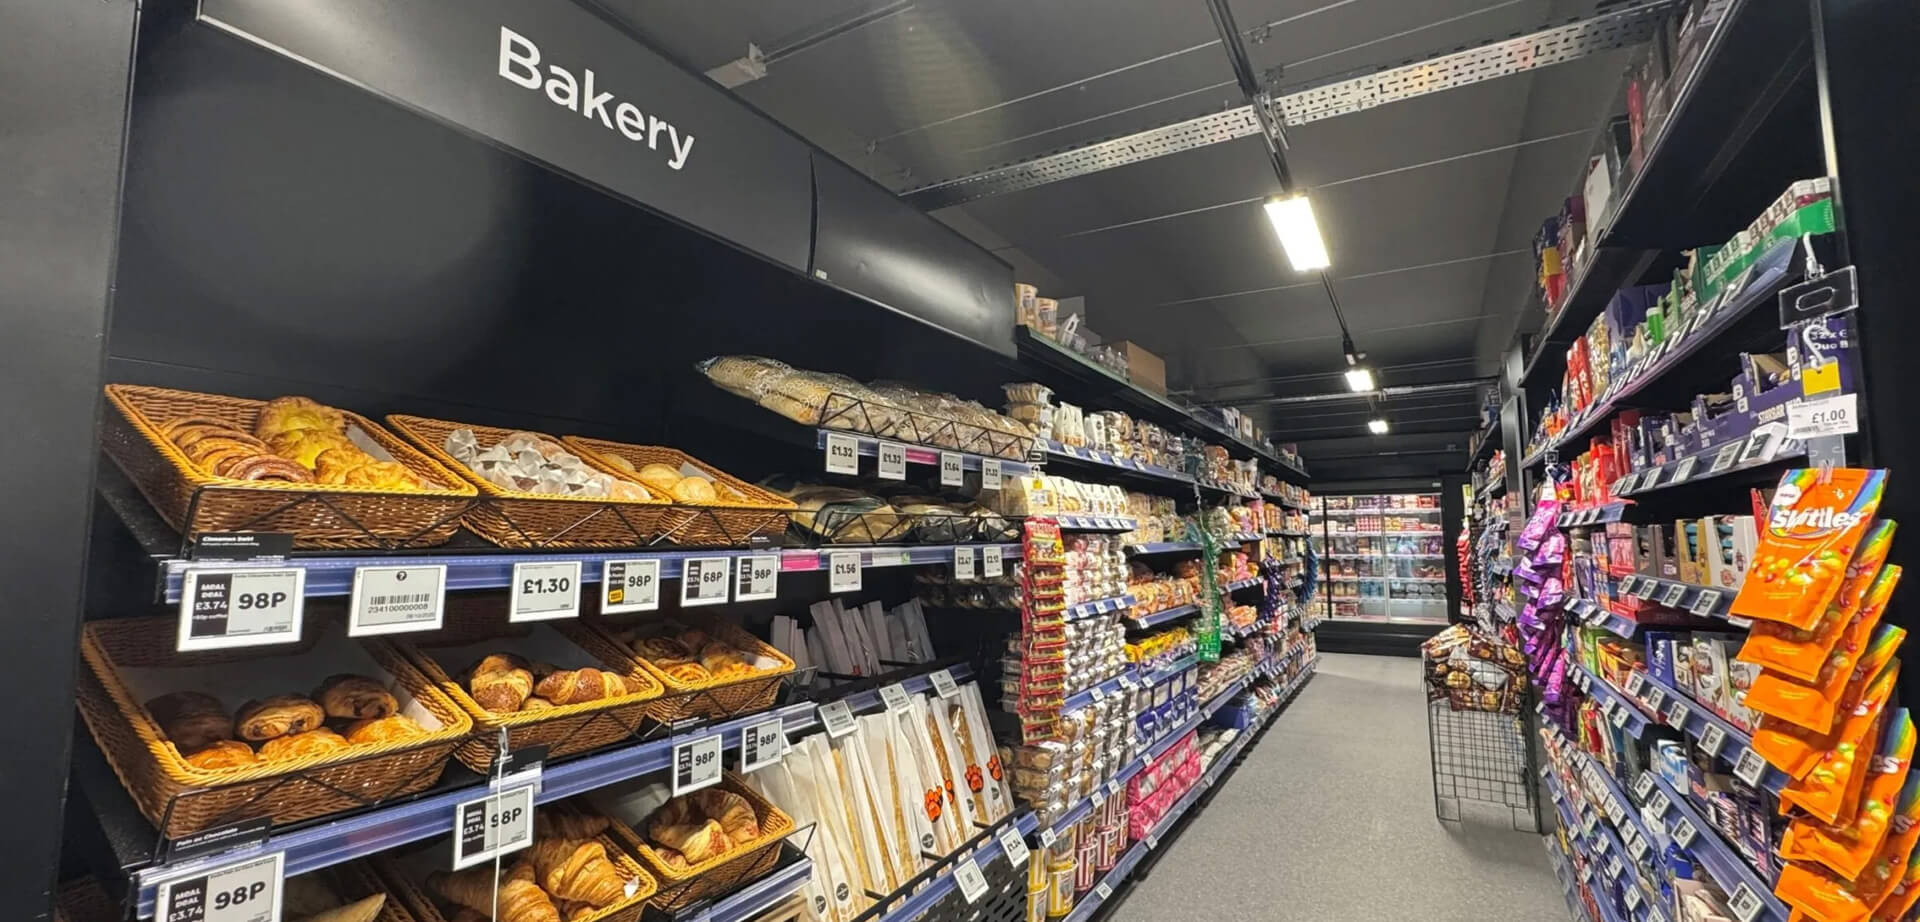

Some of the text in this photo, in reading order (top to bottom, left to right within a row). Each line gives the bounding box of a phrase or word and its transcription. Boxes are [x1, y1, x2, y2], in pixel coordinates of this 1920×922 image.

[499, 26, 695, 169] Bakery
[1812, 409, 1846, 424] £1.00
[831, 445, 854, 457] £1.32
[883, 453, 902, 464] £1.32
[754, 569, 772, 579] 98P
[835, 564, 857, 575] £1.56
[628, 575, 651, 587] 98P
[703, 572, 723, 582] 68P
[522, 578, 570, 594] £1.30
[195, 601, 228, 610] £3.74
[238, 592, 286, 610] 98P
[759, 733, 777, 746] 98P
[695, 751, 715, 766] 98P
[490, 807, 522, 828] 98P
[463, 824, 485, 836] £3.74
[174, 888, 202, 899] MEAL
[213, 881, 266, 910] 98P
[174, 897, 200, 909] DEAL
[168, 906, 204, 922] £3.74
